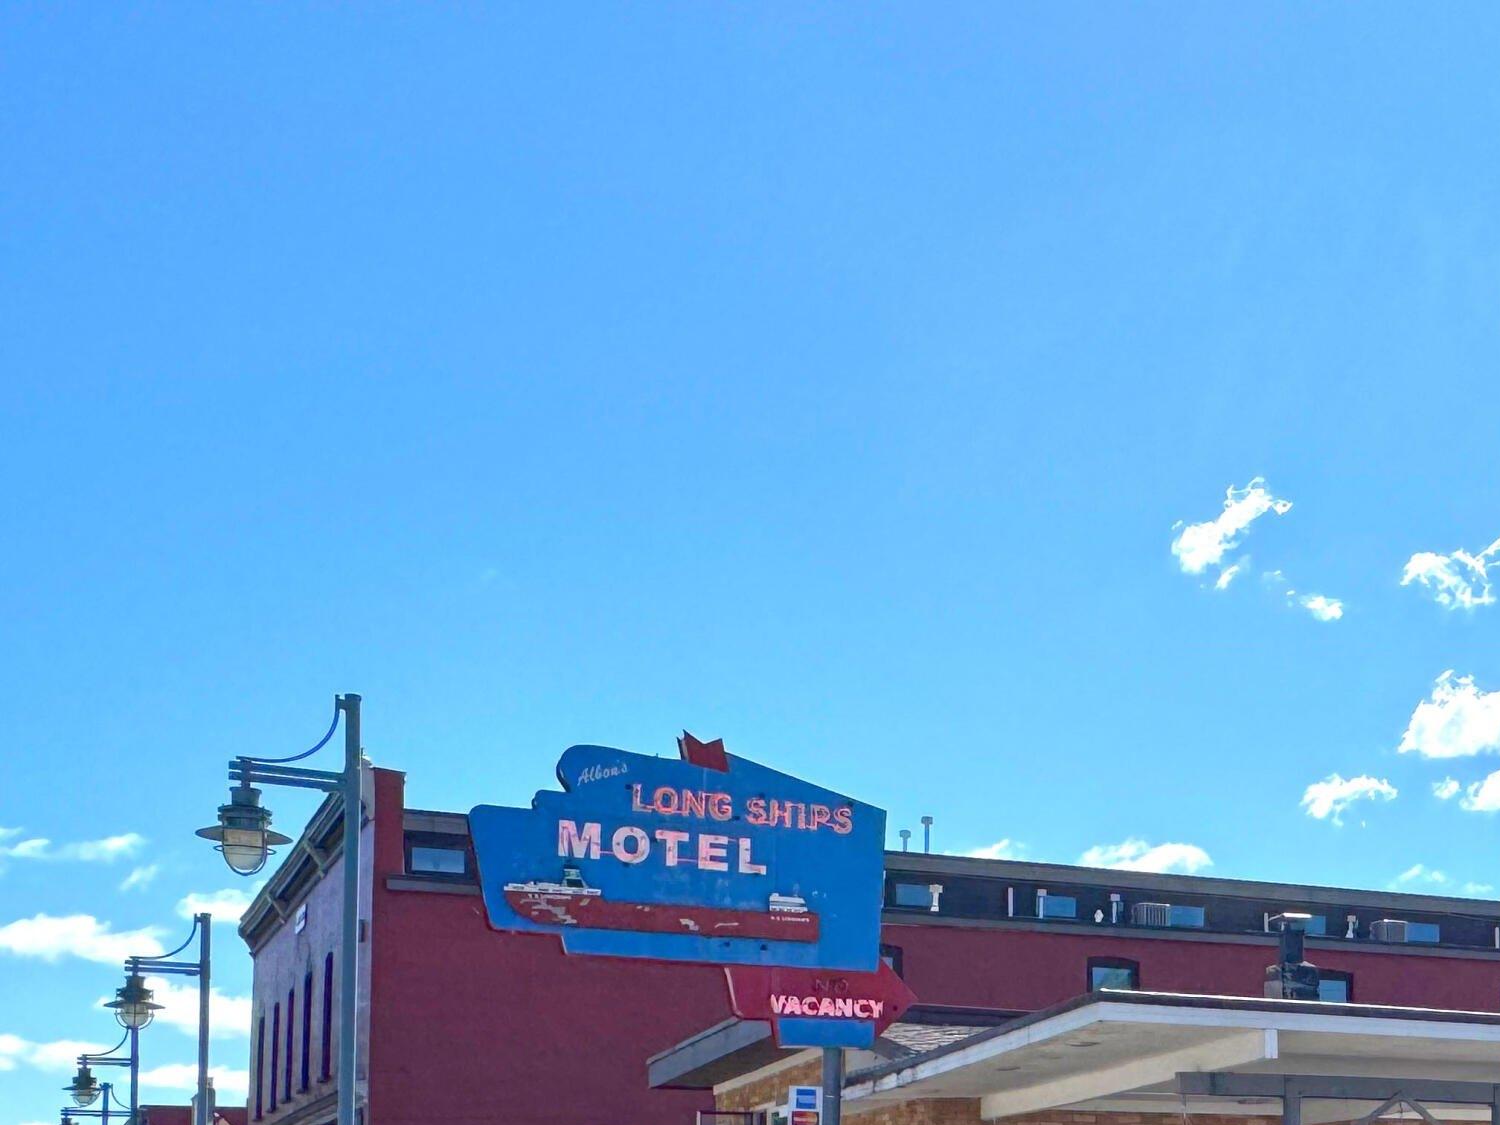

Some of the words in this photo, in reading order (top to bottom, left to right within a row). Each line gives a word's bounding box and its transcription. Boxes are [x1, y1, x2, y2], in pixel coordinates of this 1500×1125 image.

[577, 759, 628, 787] Albon's
[631, 783, 733, 822] LONG
[746, 797, 853, 835] SHIPS
[557, 819, 767, 876] MOTEL
[815, 978, 849, 994] NO
[769, 993, 884, 1019] VACANCY
